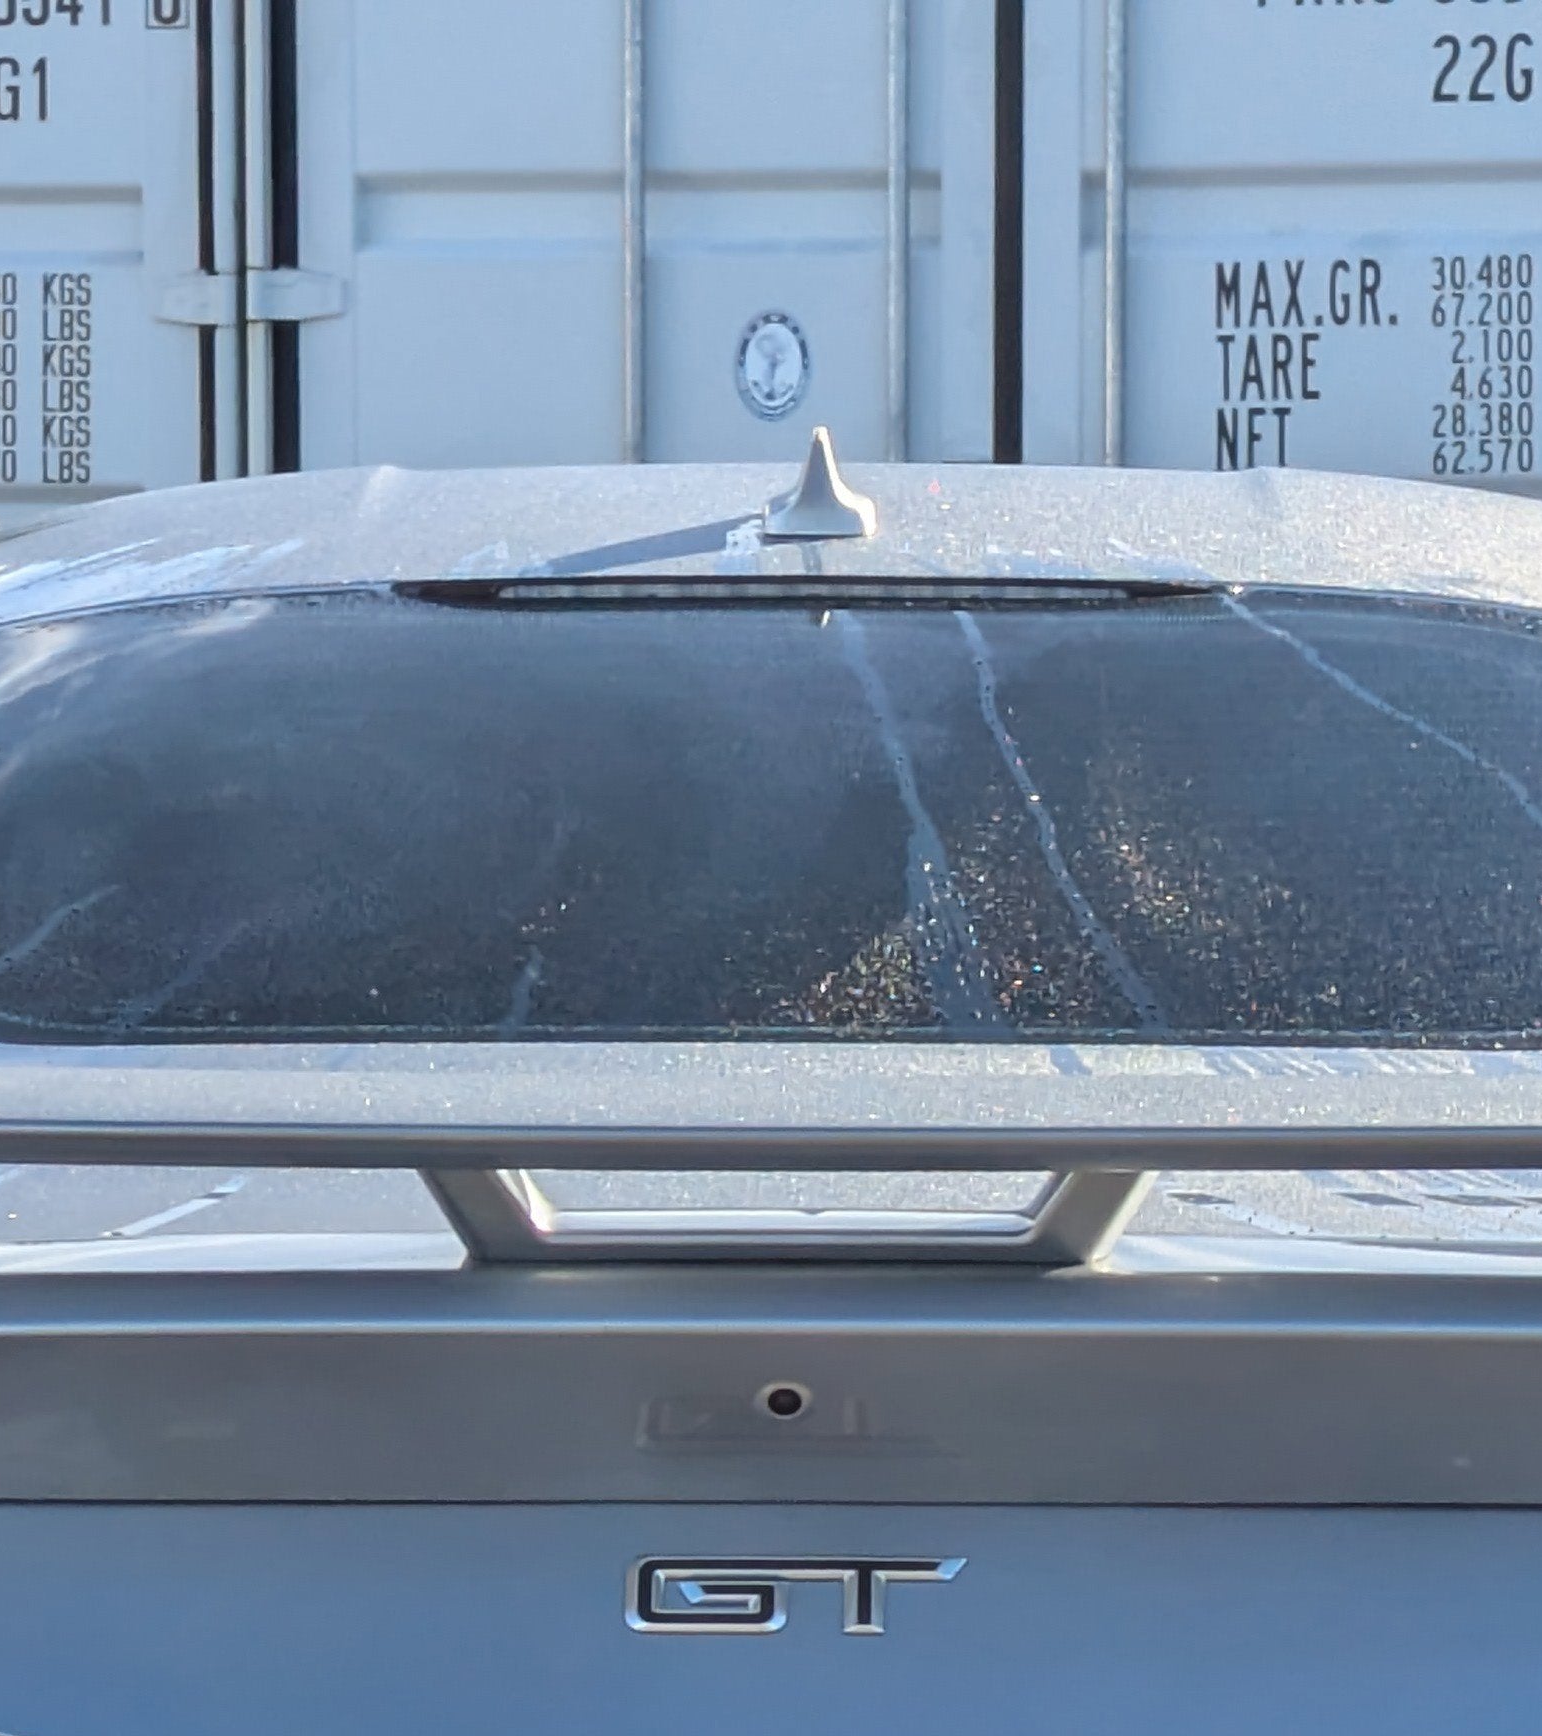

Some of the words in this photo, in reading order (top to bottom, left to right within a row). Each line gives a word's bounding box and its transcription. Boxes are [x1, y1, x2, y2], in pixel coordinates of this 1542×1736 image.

[41, 271, 92, 305] KGS
[1430, 254, 1534, 291] 30.480
[1215, 258, 1399, 329] MAX.GR.
[1430, 291, 1534, 328] 67.200
[41, 307, 92, 341] LBS
[41, 343, 92, 377] KGS
[1449, 328, 1534, 364] 2.100
[1216, 332, 1321, 402] TARE
[1449, 365, 1534, 402] 4.630
[41, 378, 92, 413] LBS
[41, 413, 92, 448] KGS
[1430, 402, 1534, 438] 28.380
[41, 449, 92, 484] LBS
[1430, 438, 1534, 475] 62.570
[625, 1555, 967, 1634] GT
